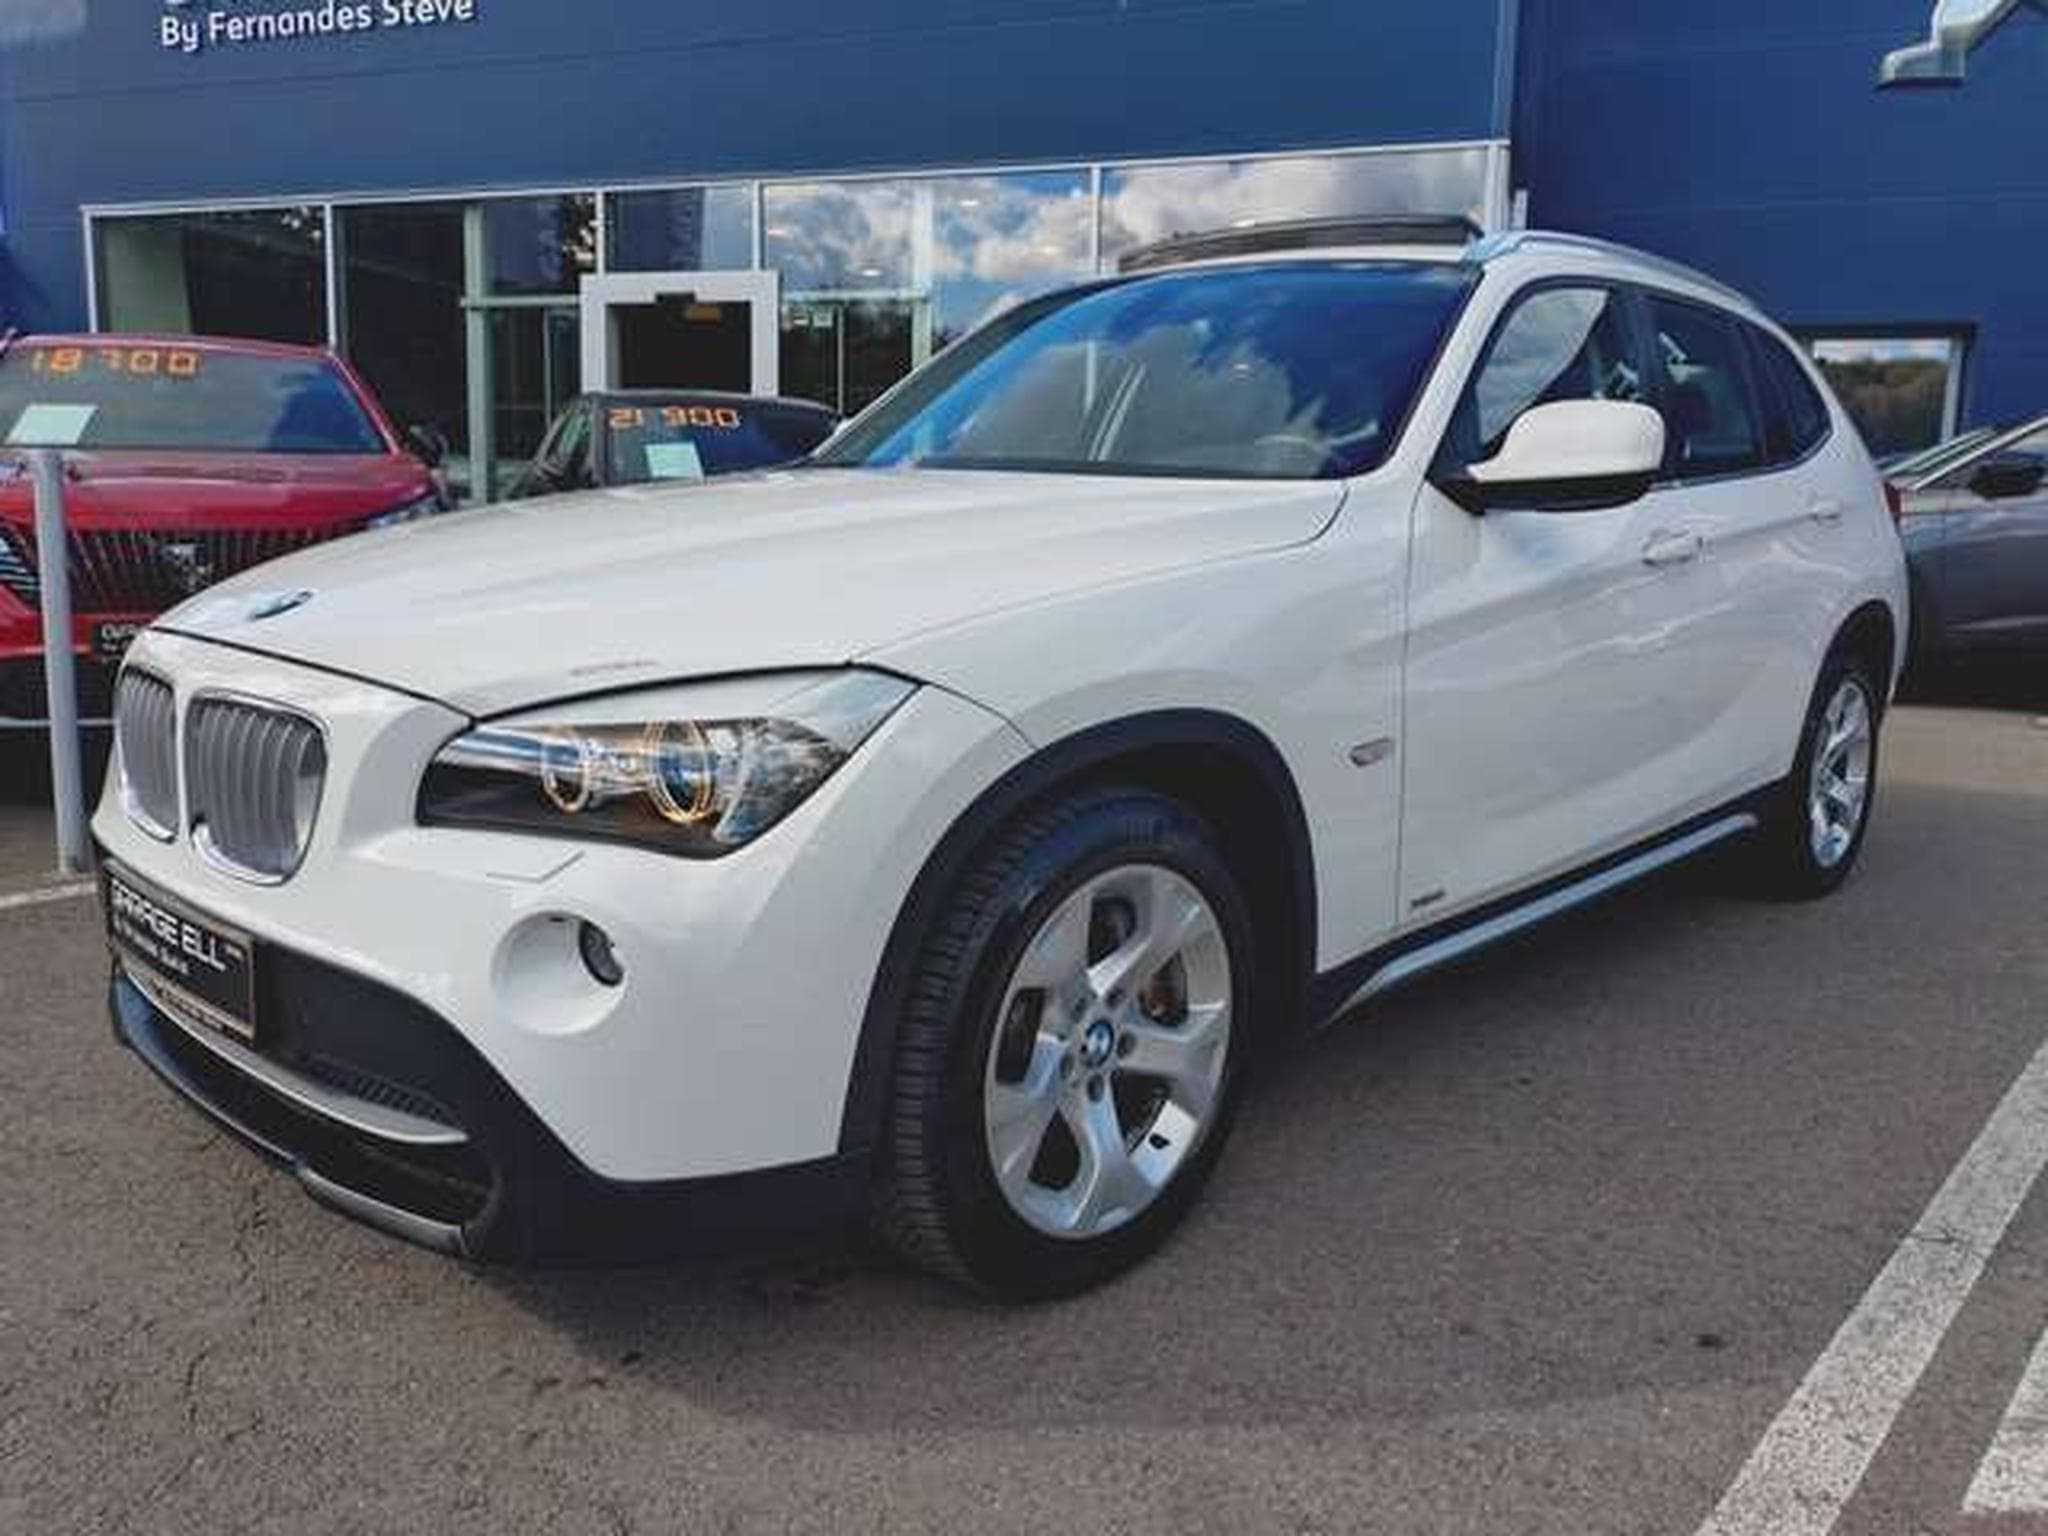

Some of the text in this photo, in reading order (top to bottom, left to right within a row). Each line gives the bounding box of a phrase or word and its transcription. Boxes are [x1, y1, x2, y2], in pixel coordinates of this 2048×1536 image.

[161, 0, 473, 52] By Fernandes Steve
[101, 348, 198, 376] 700
[609, 406, 742, 429] 21 900
[180, 922, 227, 973] ELL
